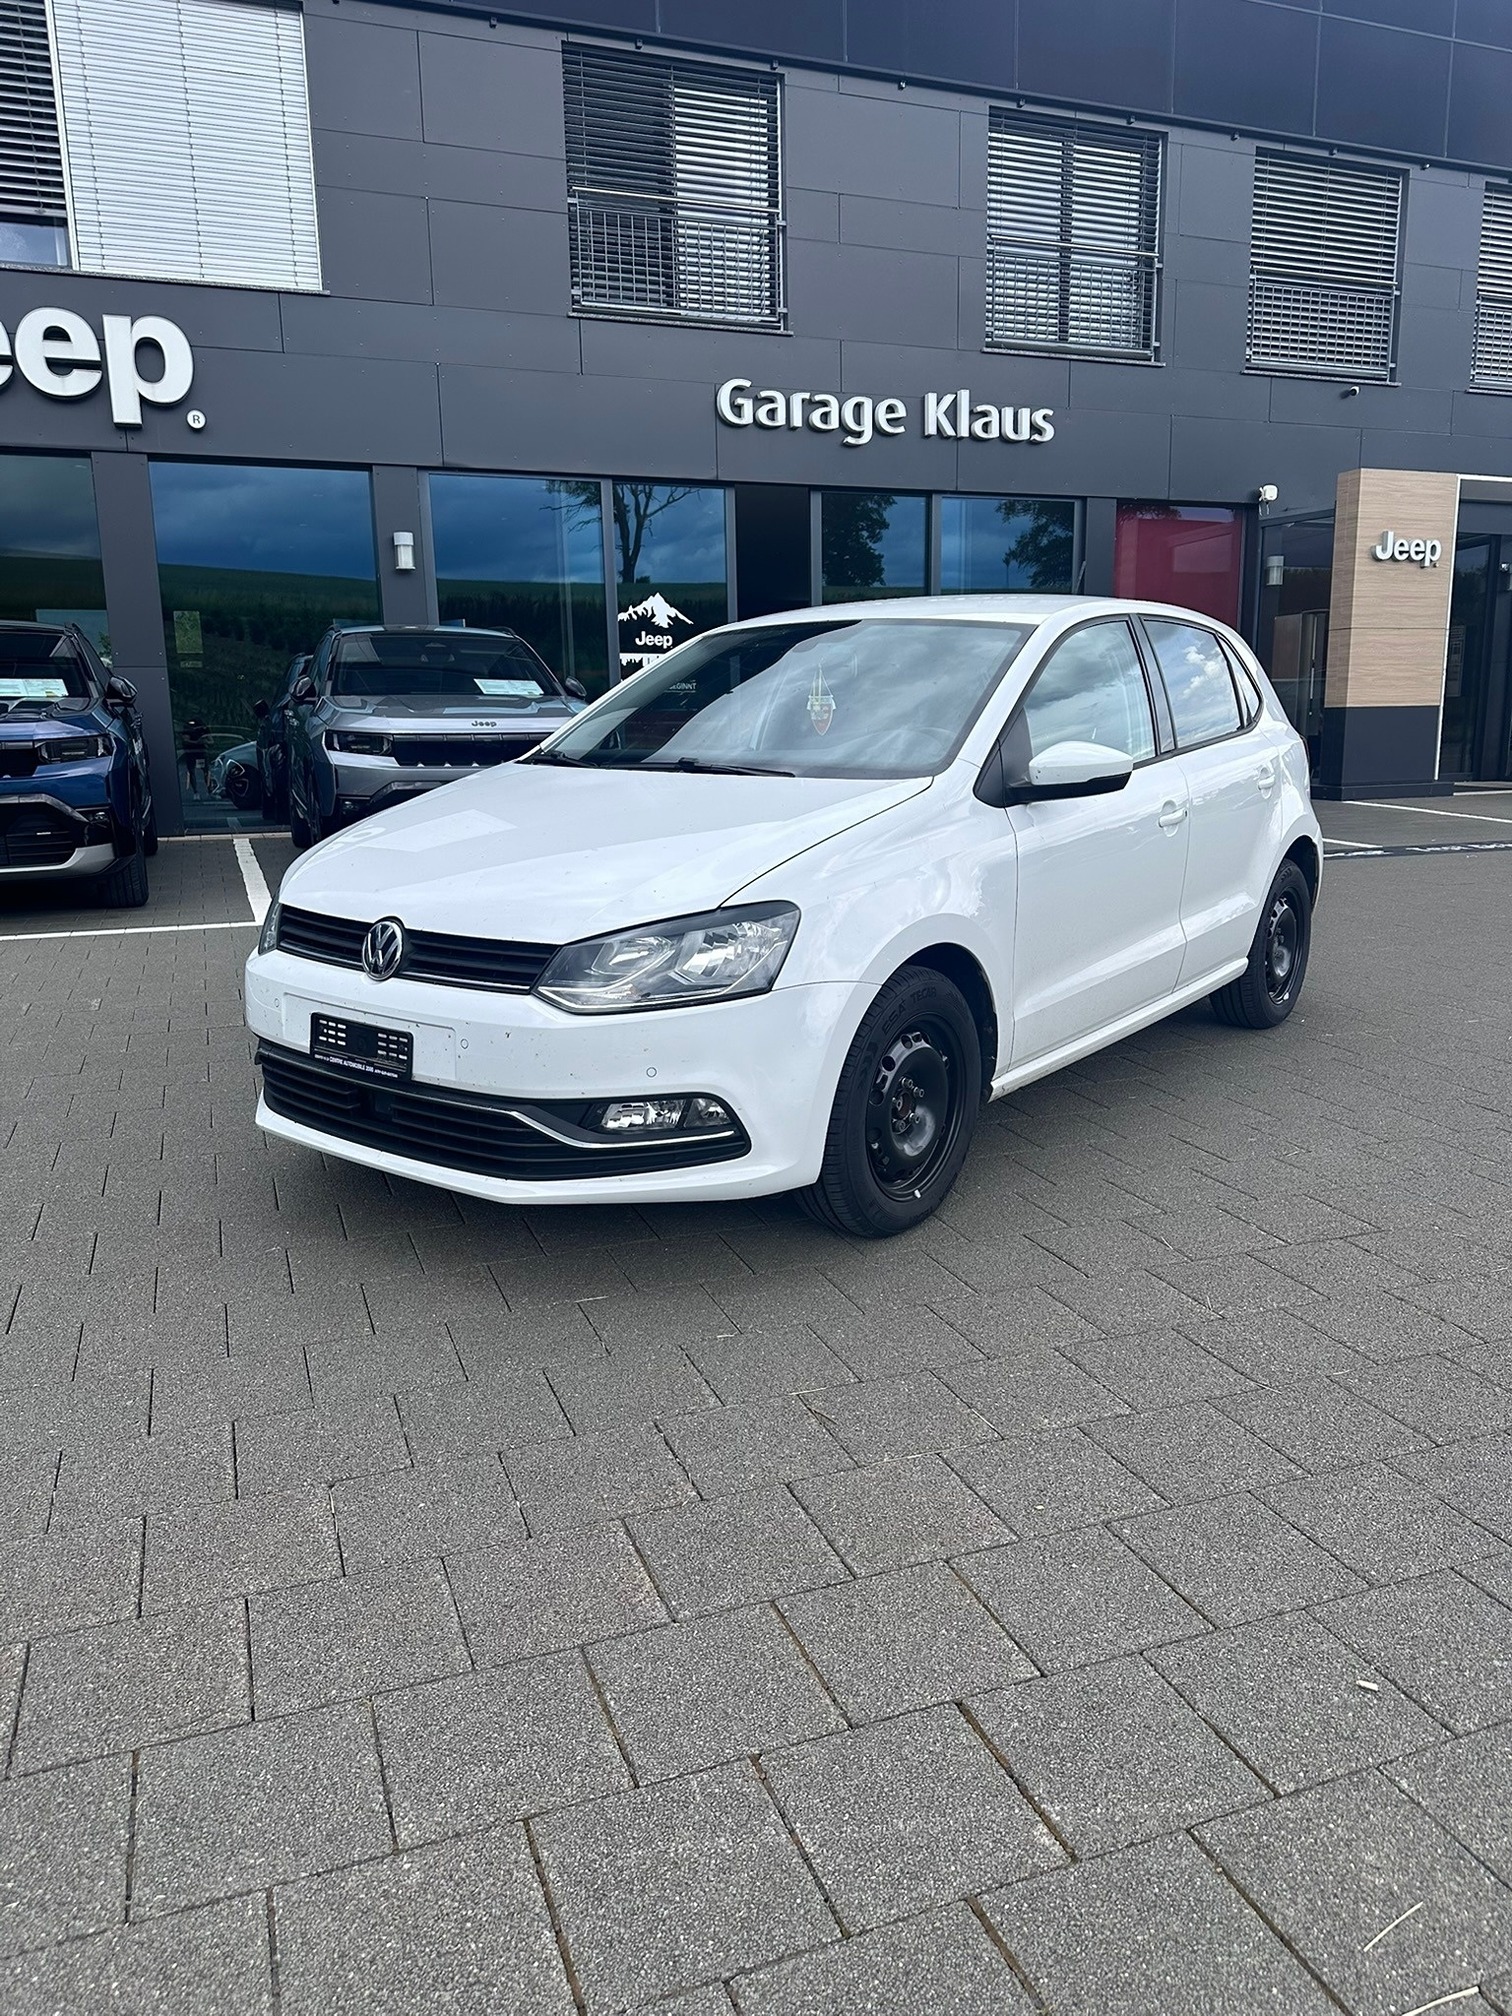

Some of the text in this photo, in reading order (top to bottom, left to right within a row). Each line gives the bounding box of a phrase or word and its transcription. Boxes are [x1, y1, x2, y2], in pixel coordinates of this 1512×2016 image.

[0, 306, 194, 428] ep
[716, 377, 1056, 447] Garage Klaus
[1371, 530, 1442, 568] Jeep
[635, 630, 673, 649] Jeep
[471, 720, 497, 728] Jeep
